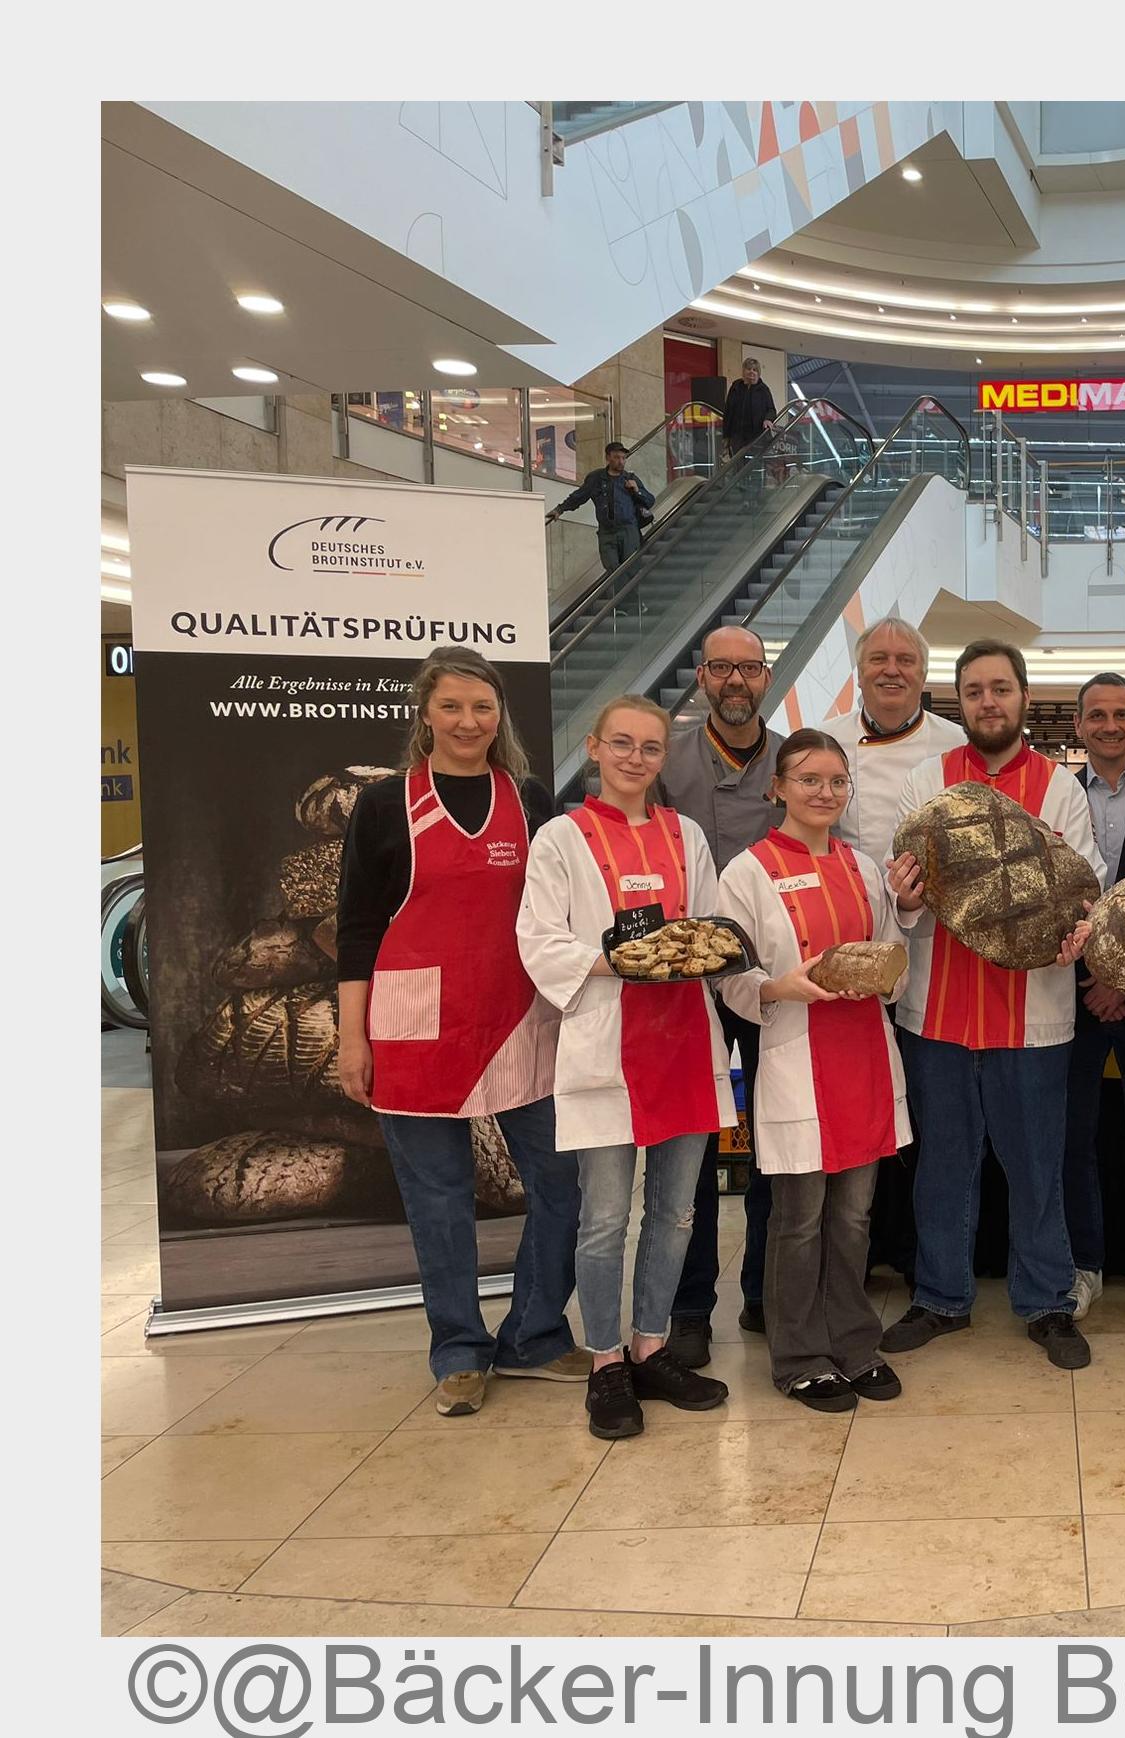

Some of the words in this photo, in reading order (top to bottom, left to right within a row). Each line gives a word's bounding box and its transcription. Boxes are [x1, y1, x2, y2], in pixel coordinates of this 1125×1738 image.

[311, 541, 385, 555] DEUTSCHES
[312, 555, 402, 569] BROTINSTITUT
[405, 560, 425, 571] e.V.
[170, 610, 517, 645] QUALITÄTSPRÜFUNG
[230, 675, 264, 691] Alle
[267, 675, 351, 696] Ergebnisse
[355, 677, 372, 692] in
[376, 677, 414, 693] Kürz
[210, 701, 420, 720] WWW.BROTINSTIT
[101, 739, 131, 764] nk
[490, 850, 516, 858] Siebert
